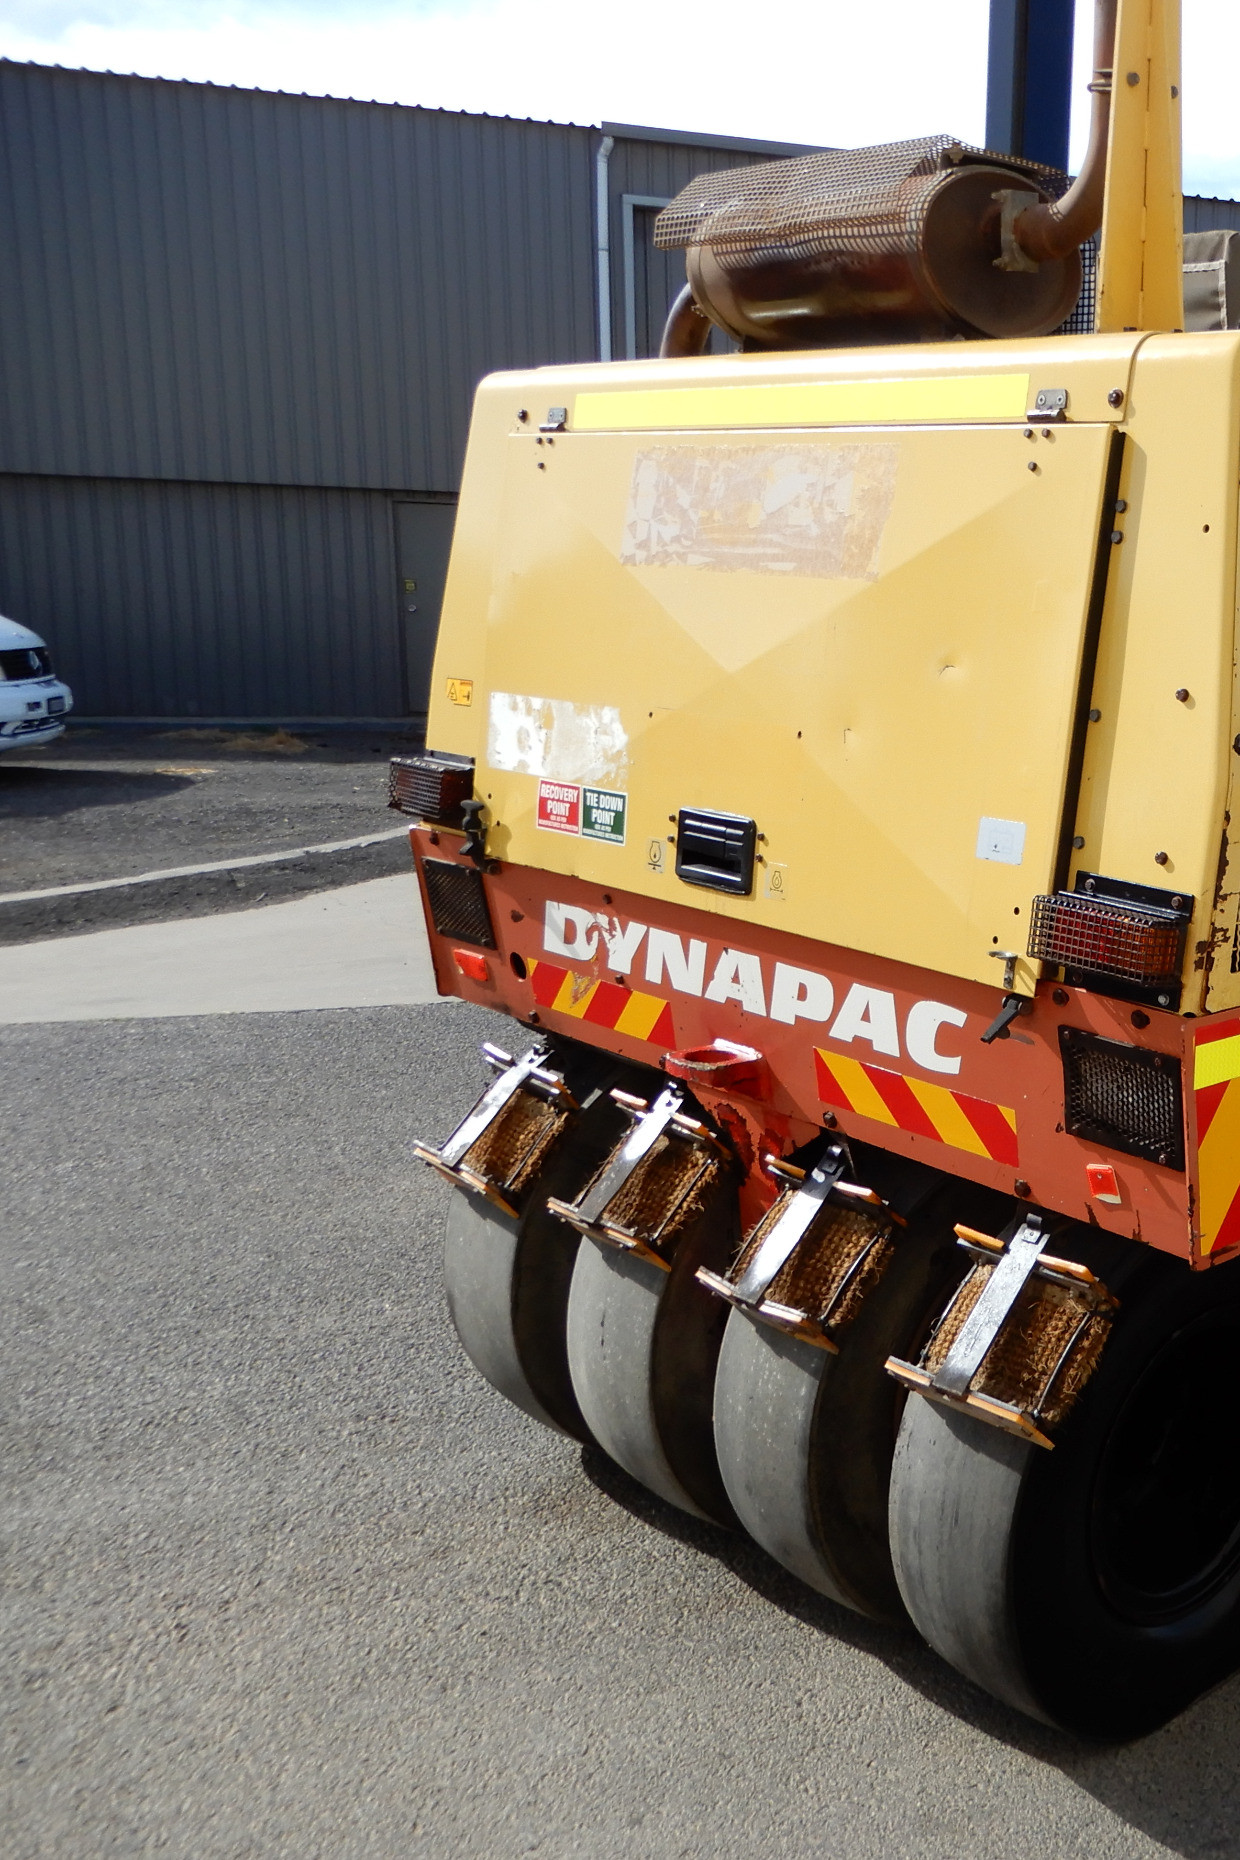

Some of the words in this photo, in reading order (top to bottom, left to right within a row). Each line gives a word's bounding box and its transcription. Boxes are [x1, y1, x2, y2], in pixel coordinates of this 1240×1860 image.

[540, 783, 579, 804] RECOVERY
[585, 792, 599, 807] TIE
[599, 795, 624, 812] DOWN
[547, 800, 571, 817] POINT
[591, 808, 616, 826] POINT
[543, 900, 968, 1075] DYNAPAC
